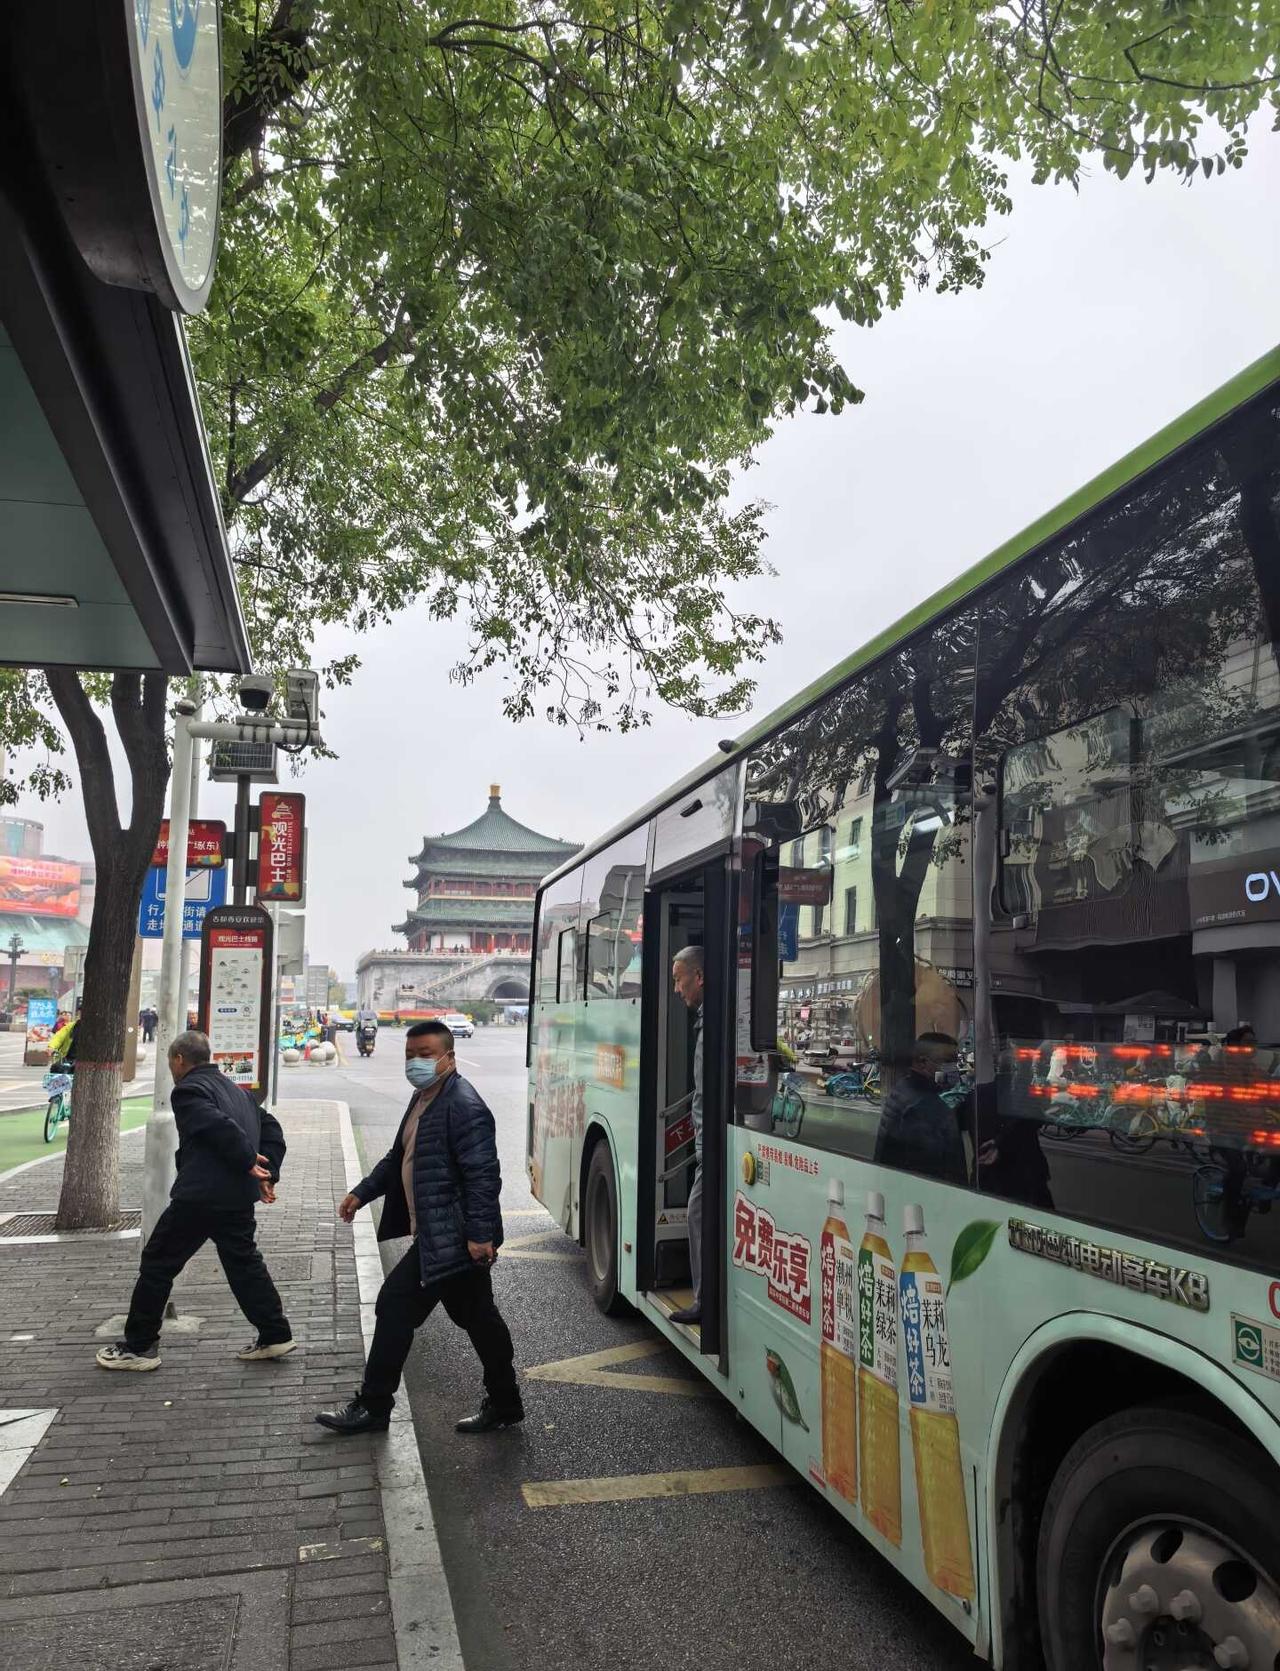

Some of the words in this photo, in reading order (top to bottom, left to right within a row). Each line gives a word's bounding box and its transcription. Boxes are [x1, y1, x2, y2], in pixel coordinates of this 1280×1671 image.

[270, 821, 287, 883] 观光巴士
[734, 1198, 809, 1294] 免费乐享
[821, 1242, 836, 1334] 焙好茶
[858, 1260, 874, 1360] 焙好茶
[900, 1283, 924, 1396] 焙好茶
